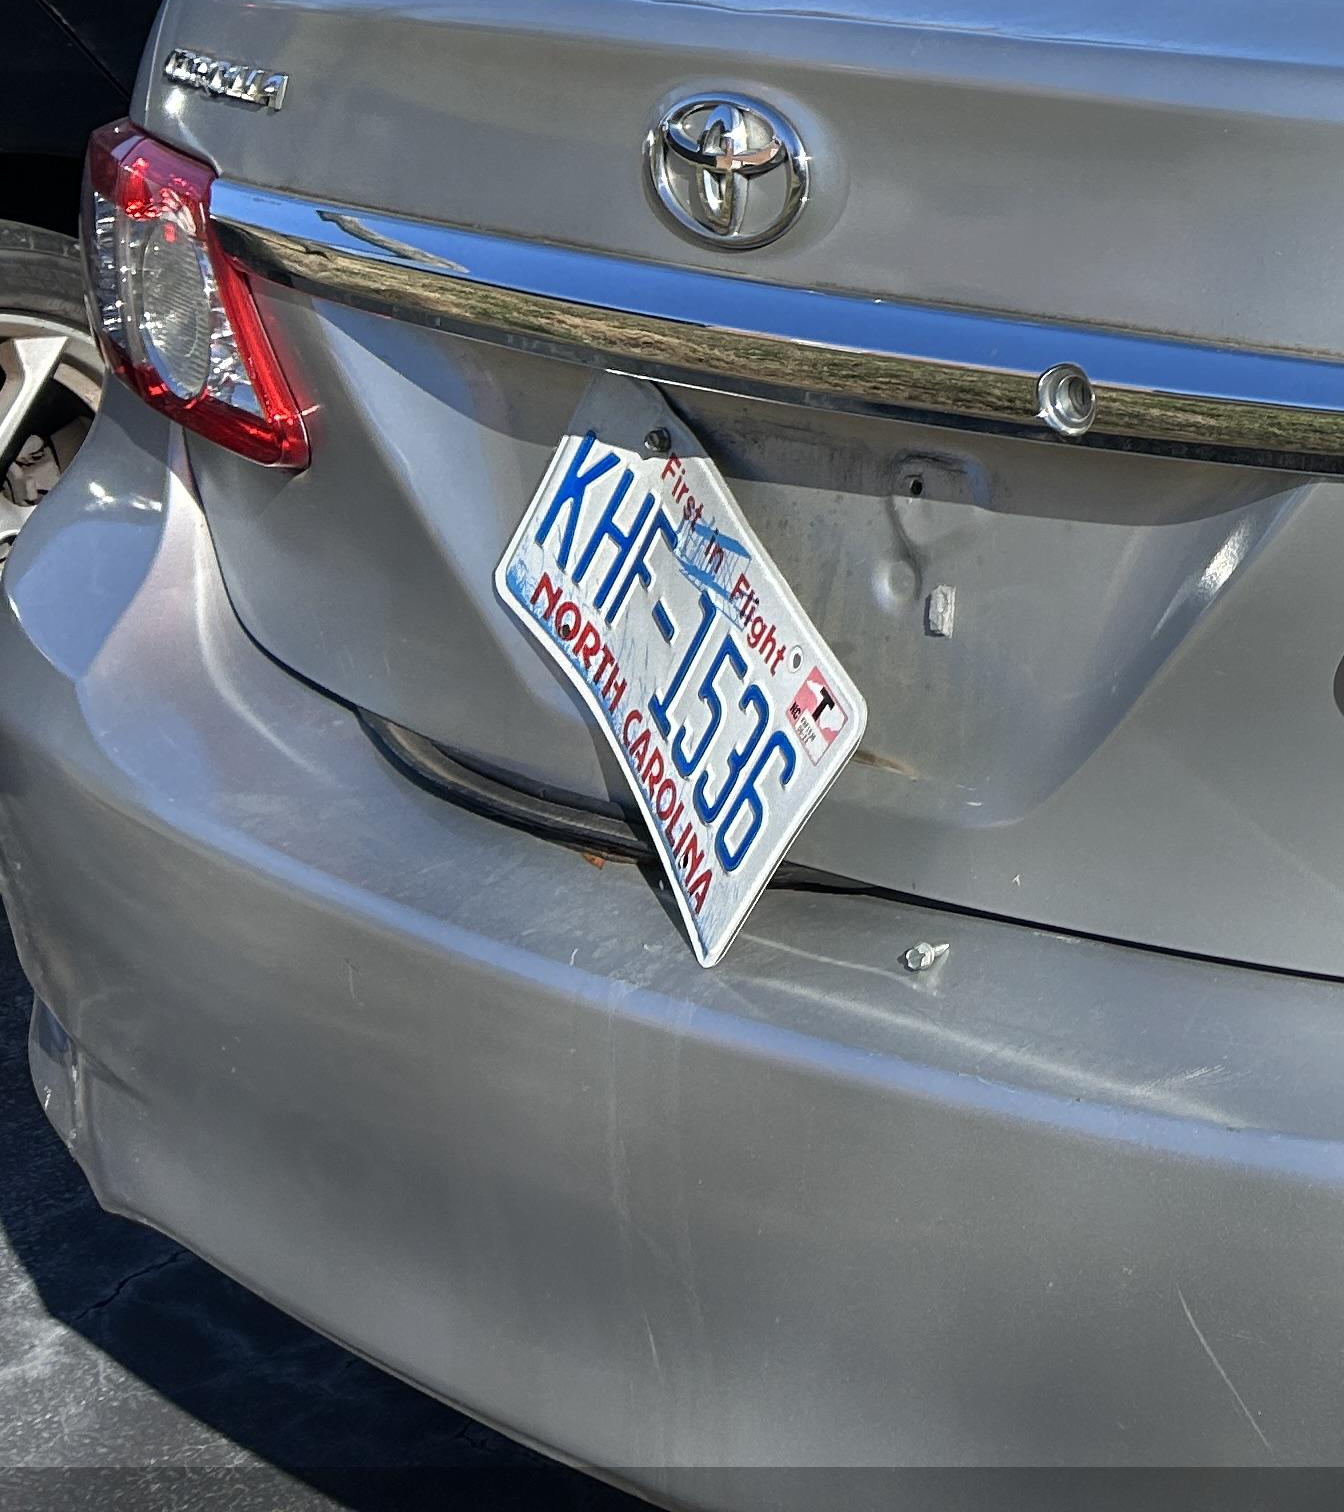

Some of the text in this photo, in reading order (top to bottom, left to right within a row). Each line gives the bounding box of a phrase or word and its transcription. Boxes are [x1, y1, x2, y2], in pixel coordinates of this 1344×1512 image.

[533, 430, 796, 872] KHF-1536
[661, 452, 786, 676] First in Flight
[530, 572, 713, 914] NORTH CAROLINA
